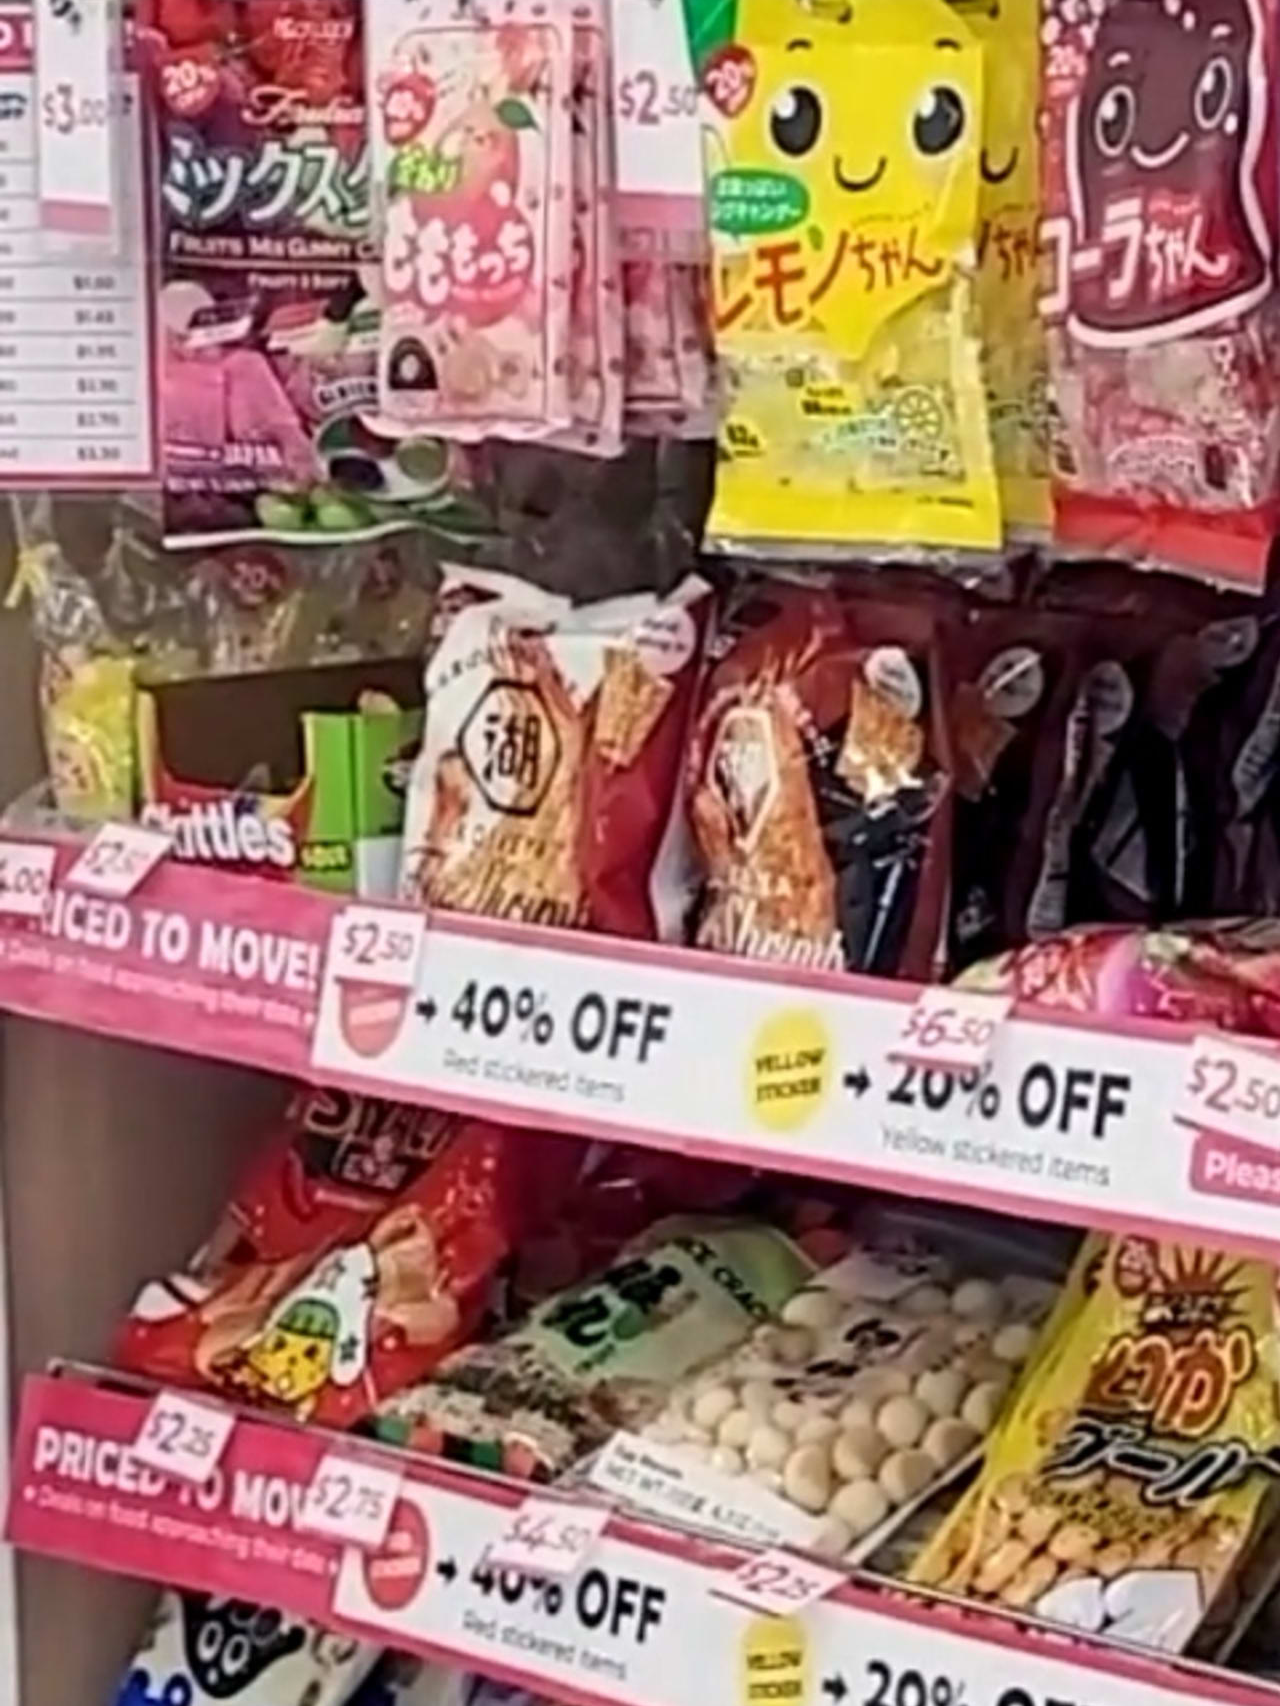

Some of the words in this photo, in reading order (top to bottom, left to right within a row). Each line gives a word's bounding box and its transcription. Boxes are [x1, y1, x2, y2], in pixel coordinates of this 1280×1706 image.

[619, 70, 696, 126] $2.50
[142, 911, 190, 962] TO
[199, 921, 322, 989] MOVE!
[343, 922, 414, 965] $2.50
[452, 980, 556, 1045] 40%
[570, 994, 673, 1064] OFF
[902, 1006, 996, 1050] $6.50
[1017, 1061, 1132, 1140] OFF
[951, 1133, 1042, 1177] stickered
[1046, 1153, 1110, 1188] items
[576, 1568, 668, 1644] OFF
